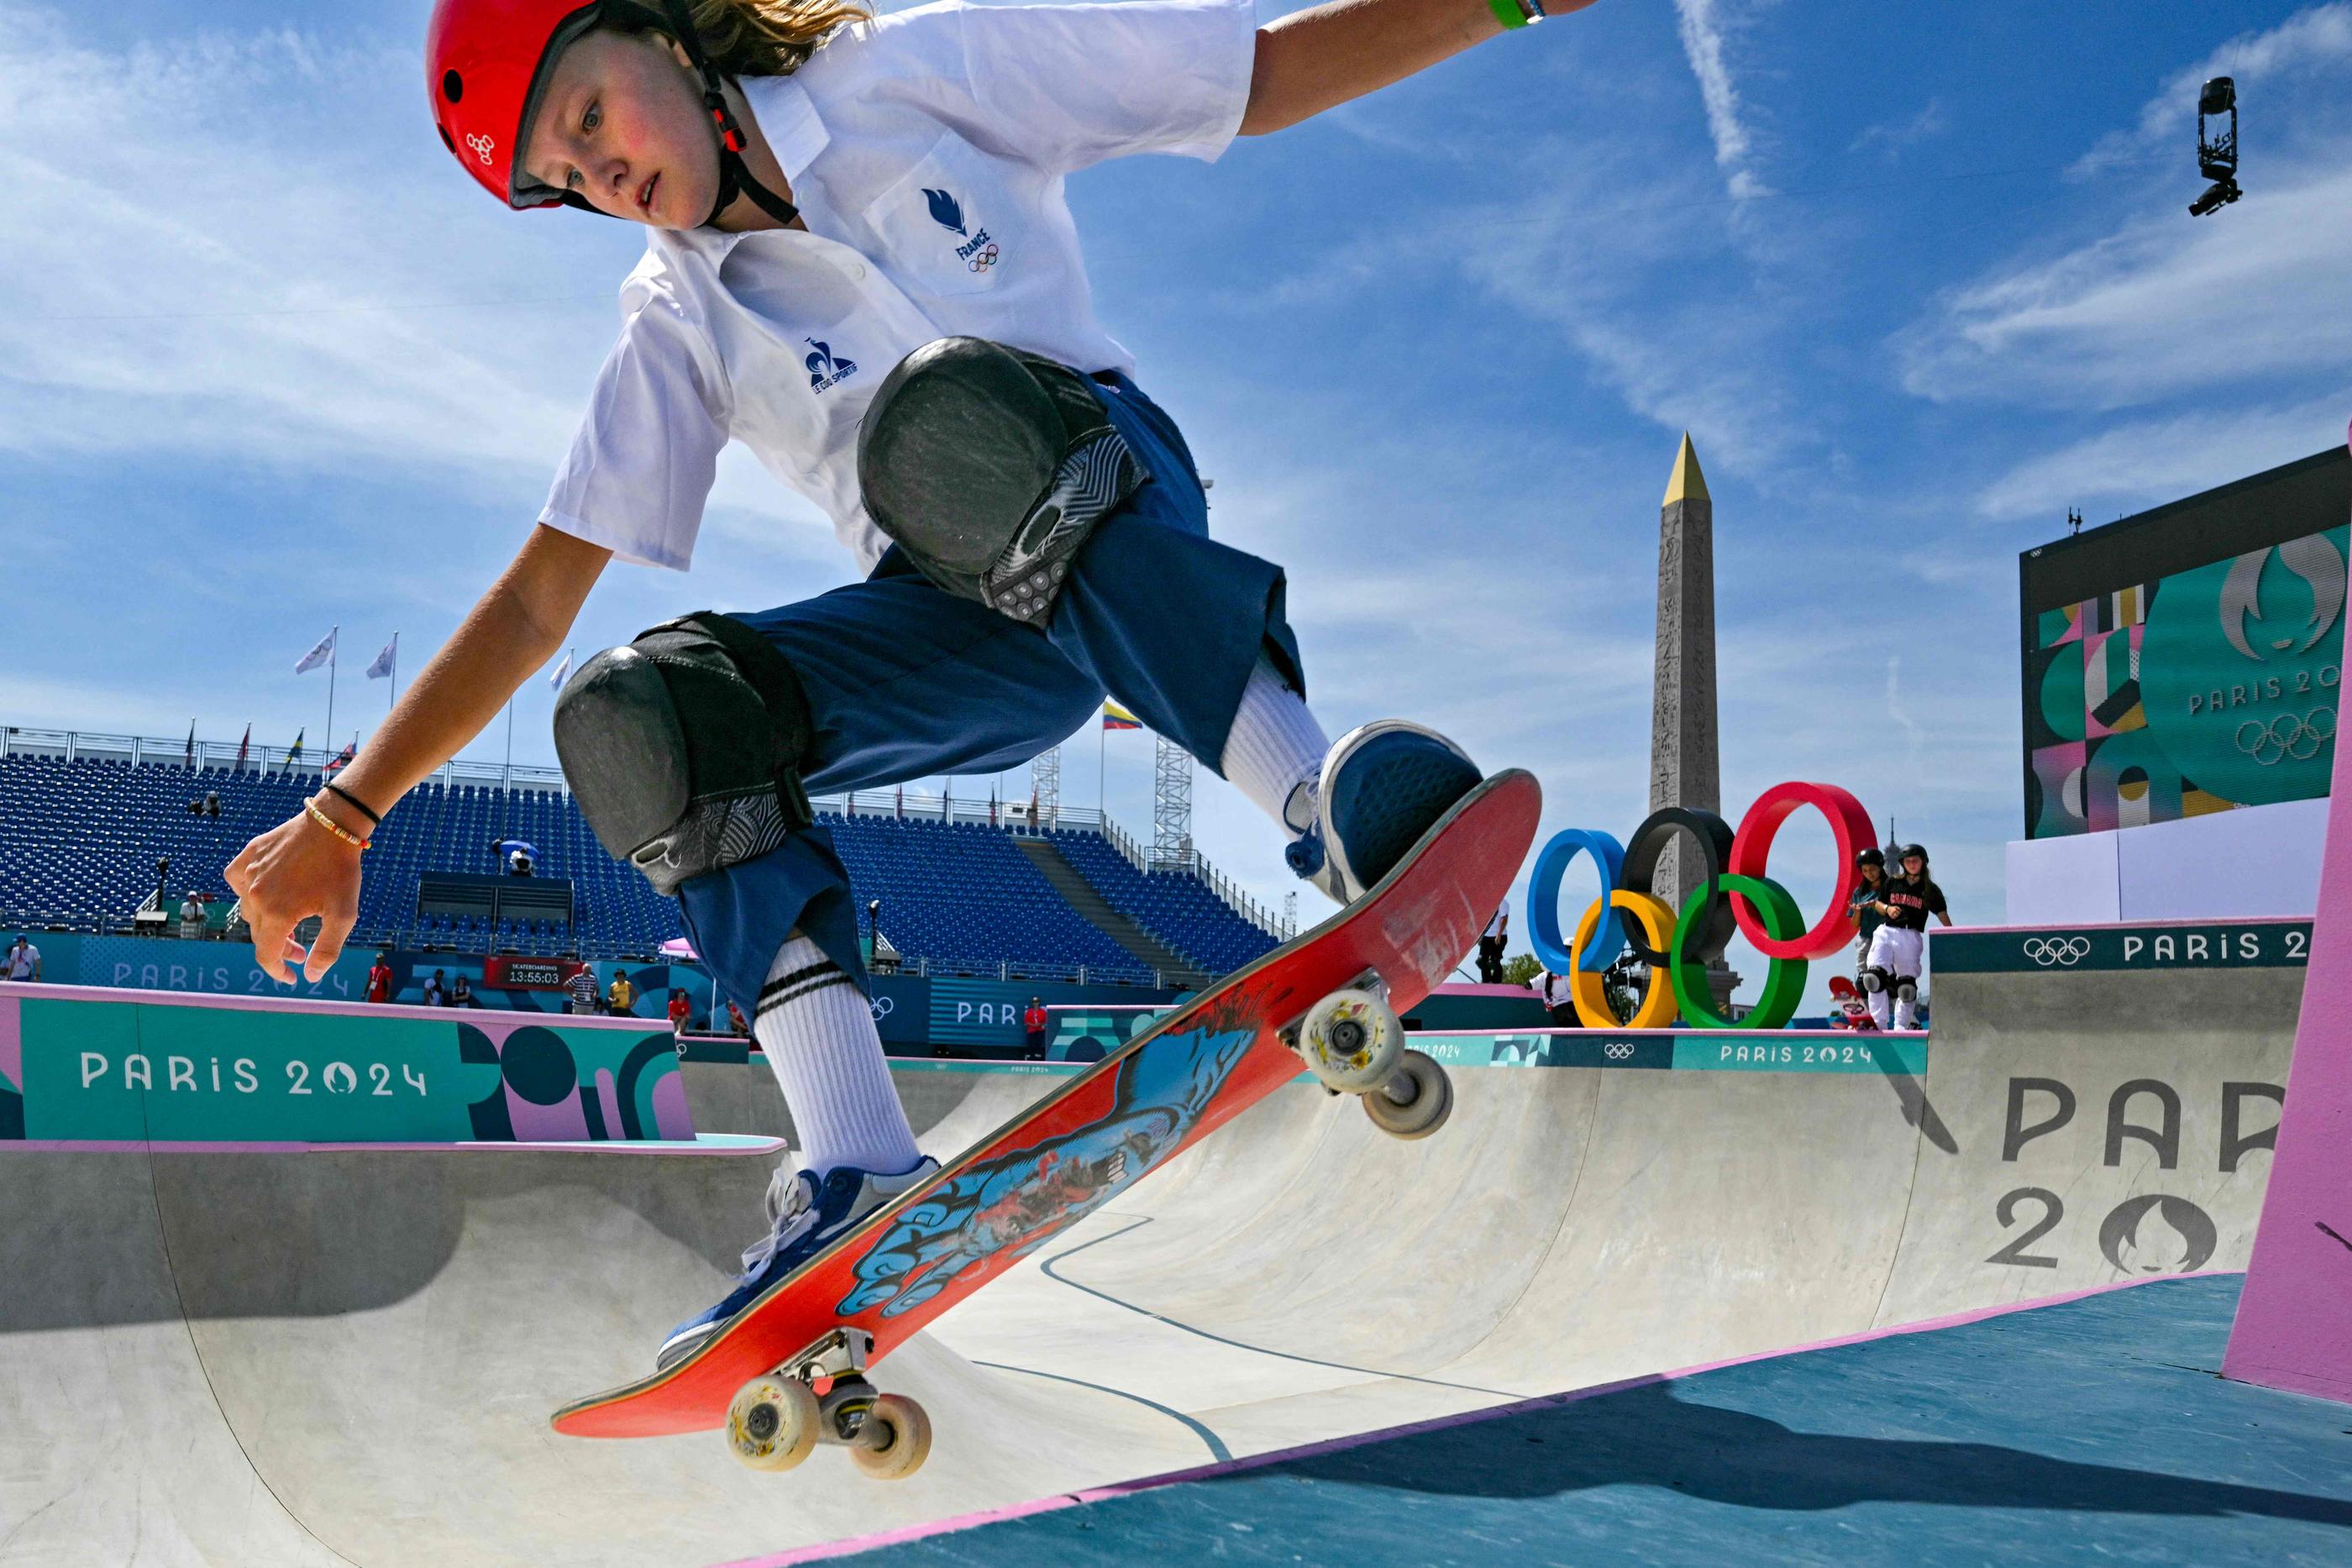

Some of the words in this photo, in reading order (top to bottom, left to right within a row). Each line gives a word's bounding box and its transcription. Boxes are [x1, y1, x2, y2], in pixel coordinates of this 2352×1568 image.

[955, 228, 990, 260] FRANCE
[2189, 677, 2281, 715] PARIS
[1889, 893, 1923, 910] CANADA
[958, 1001, 1029, 1025] PAR
[1431, 1044, 1460, 1058] 2024
[1803, 1046, 1872, 1063] 2024
[286, 1060, 427, 1096] 2024
